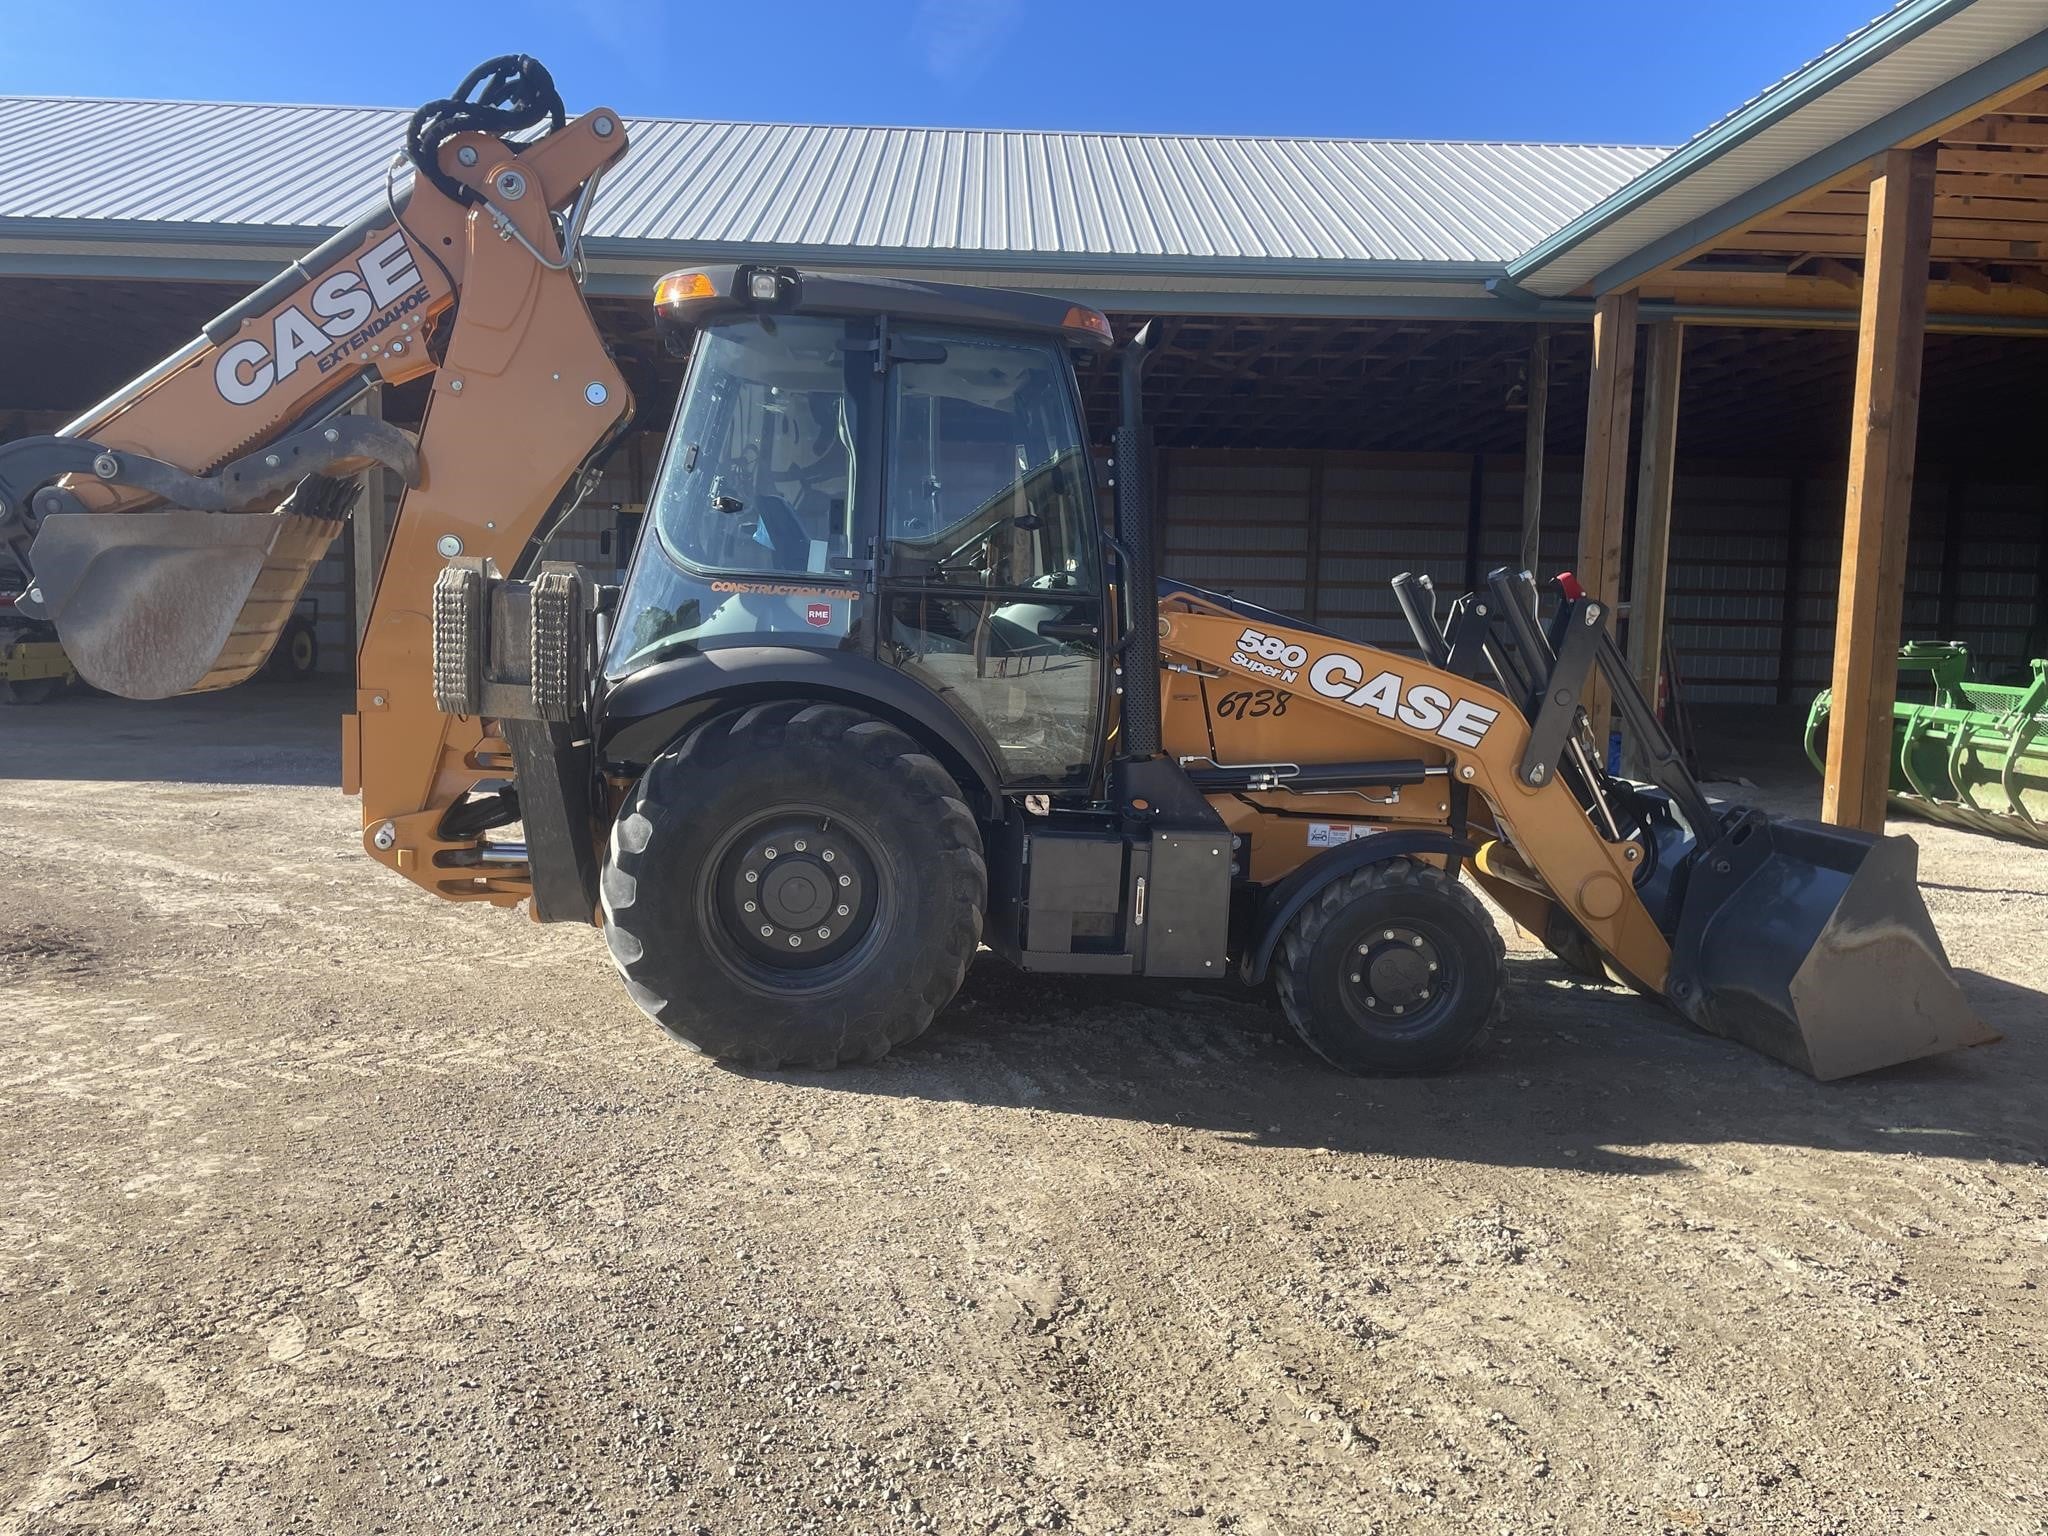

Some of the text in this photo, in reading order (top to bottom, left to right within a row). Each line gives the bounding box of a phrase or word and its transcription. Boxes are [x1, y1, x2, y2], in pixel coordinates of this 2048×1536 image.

[214, 231, 423, 406] CASE
[317, 286, 430, 373] EXTENDAHOE
[711, 581, 860, 600] CONSTRUCTION KING
[809, 610, 829, 618] RME
[1236, 628, 1308, 668] 580
[1230, 651, 1298, 684] Super N
[1217, 690, 1293, 720] 6738
[1308, 653, 1500, 749] CASE
